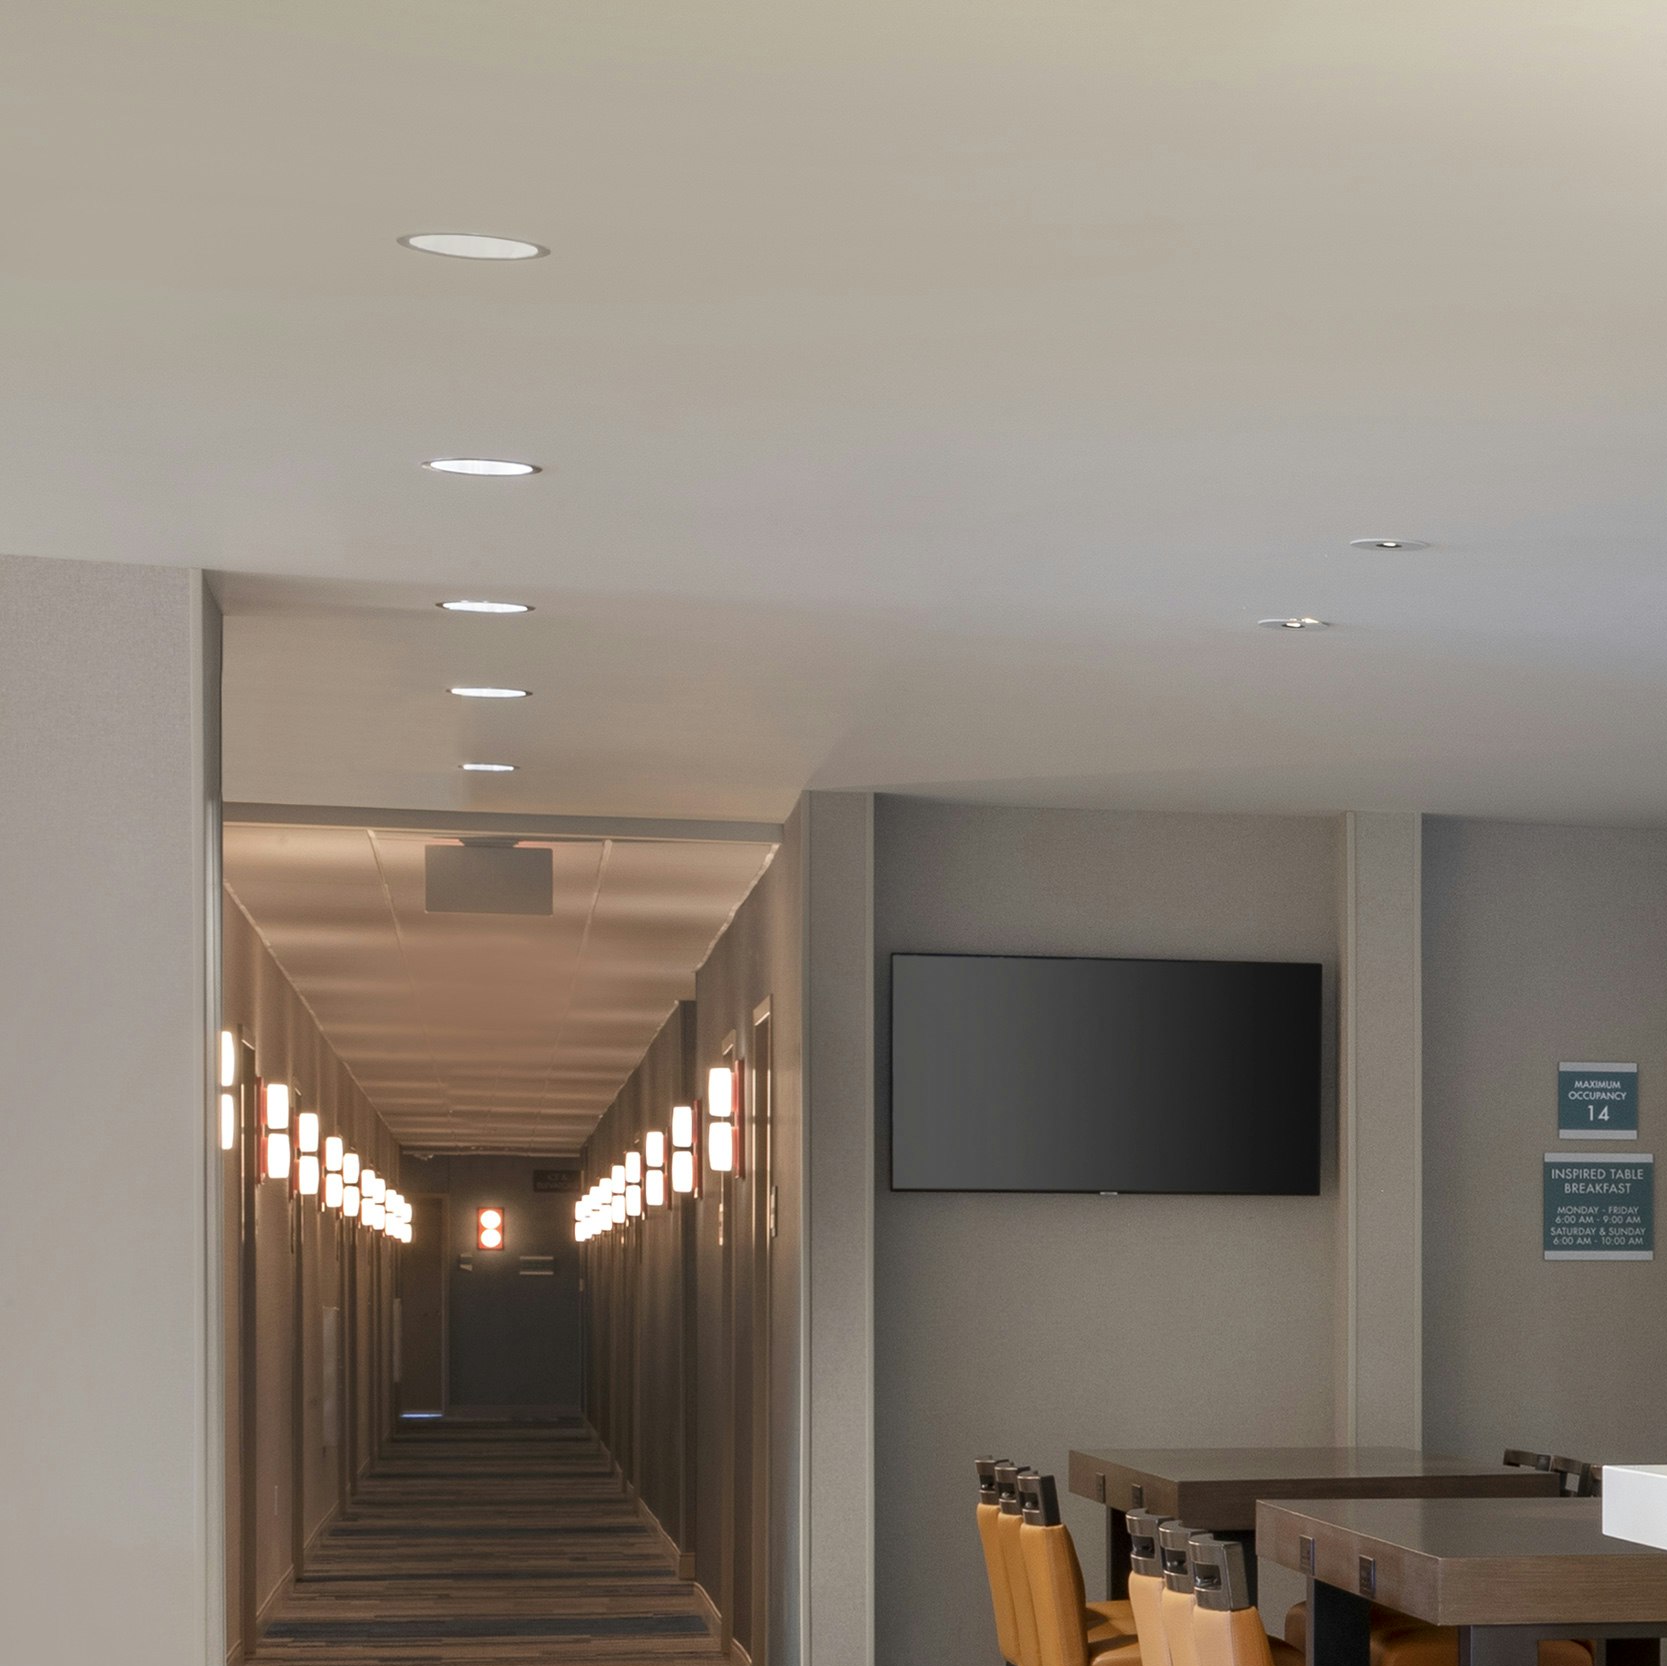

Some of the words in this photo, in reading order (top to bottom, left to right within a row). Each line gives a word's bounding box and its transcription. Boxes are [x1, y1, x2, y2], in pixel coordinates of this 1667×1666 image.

[1574, 1080, 1621, 1089] MAXIMUM
[1568, 1091, 1627, 1101] OCCUPANCY
[1587, 1105, 1610, 1122] 14
[1551, 1168, 1606, 1180] INSPIRED
[1610, 1169, 1644, 1180] TABLE
[1564, 1183, 1631, 1194] BREAKFAST
[1557, 1206, 1599, 1214] MONDAY
[1608, 1206, 1639, 1214] FRIDAY
[1555, 1215, 1576, 1224] 6:00
[1578, 1215, 1594, 1224] AM
[1603, 1215, 1623, 1224] 9:00
[1625, 1215, 1641, 1224] AM
[1551, 1227, 1596, 1236] SATURDAY
[1599, 1227, 1607, 1236] &
[1609, 1227, 1646, 1236] SUNDAY
[1553, 1237, 1573, 1245] 6:00
[1576, 1237, 1592, 1245] AM
[1601, 1237, 1624, 1246] 10:00
[1627, 1237, 1643, 1245] AM
